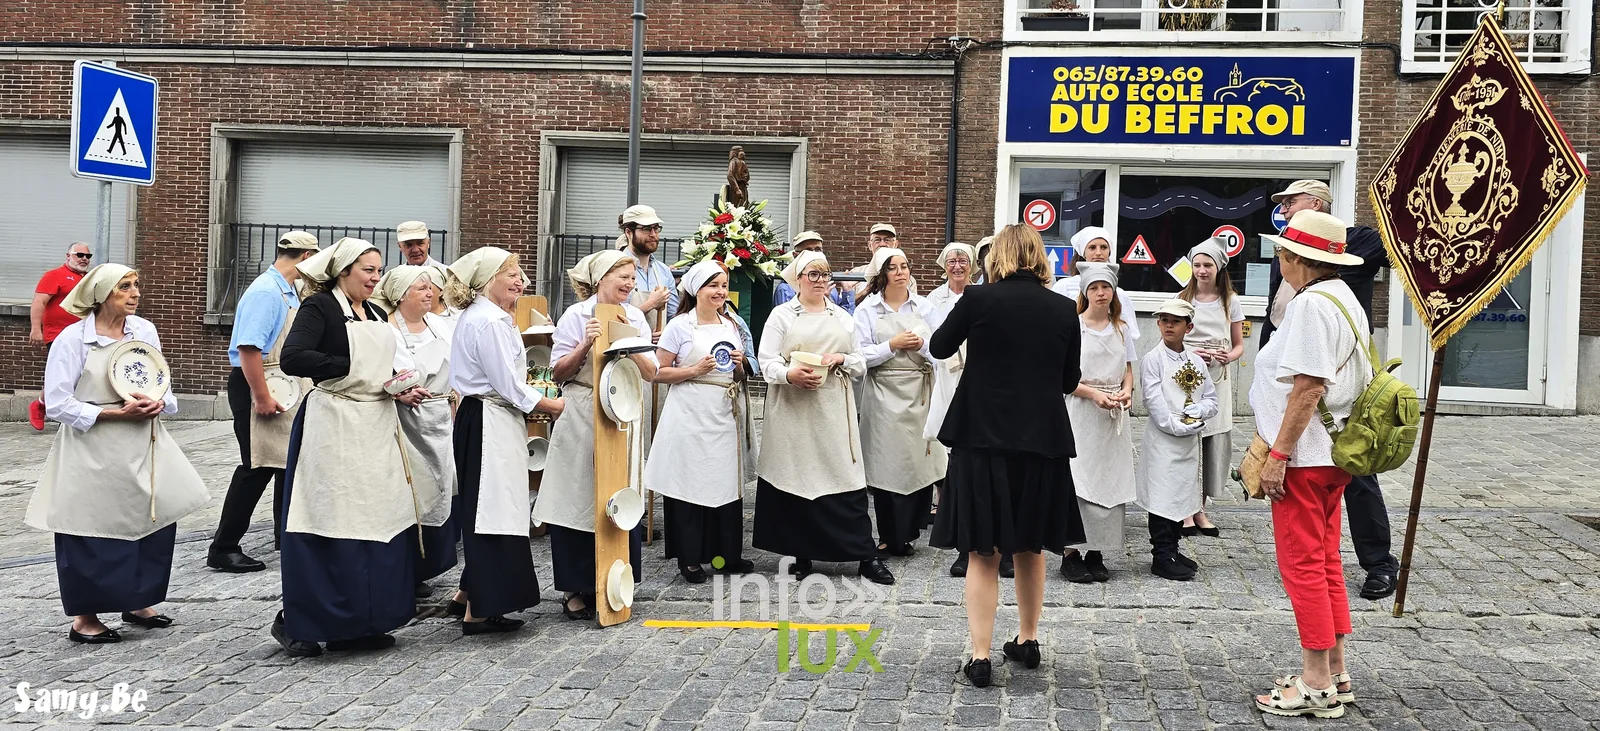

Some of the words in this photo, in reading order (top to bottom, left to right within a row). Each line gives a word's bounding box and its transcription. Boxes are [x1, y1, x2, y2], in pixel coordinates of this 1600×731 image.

[1053, 65, 1204, 82] 065/87.39.60
[1051, 83, 1120, 102] AUTO
[1126, 84, 1203, 102] ECOLE
[1050, 103, 1110, 134] DU
[1125, 103, 1305, 136] BEFFROI
[1476, 123, 1491, 137] DE
[1489, 133, 1505, 160] NIMY
[1219, 234, 1238, 247] 0
